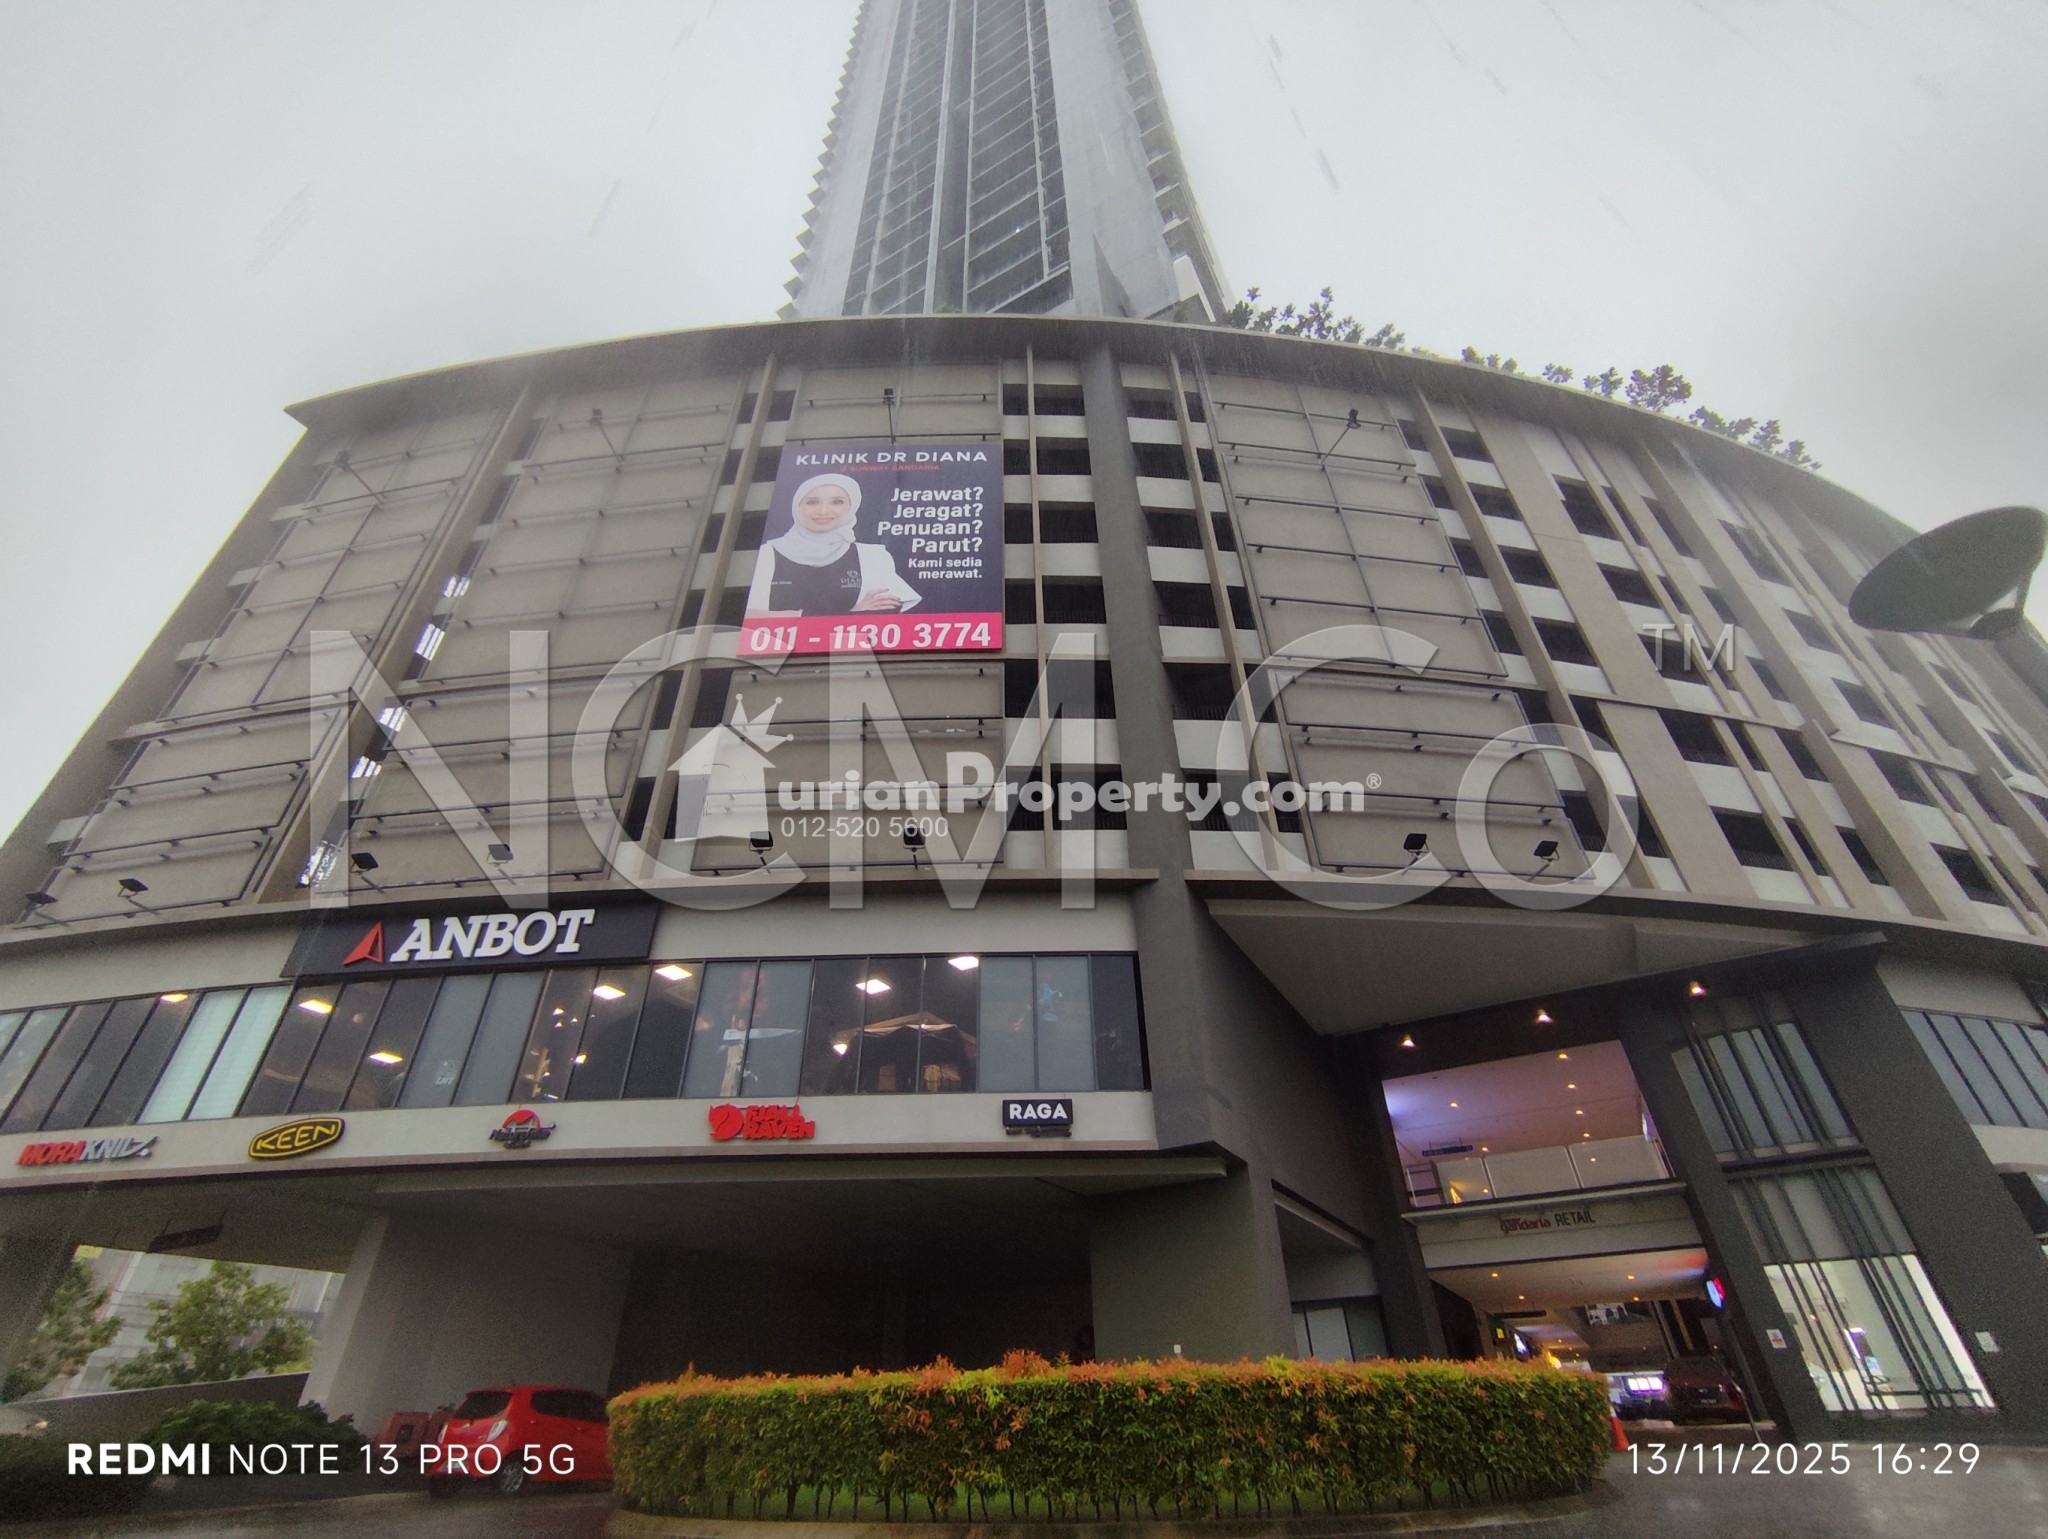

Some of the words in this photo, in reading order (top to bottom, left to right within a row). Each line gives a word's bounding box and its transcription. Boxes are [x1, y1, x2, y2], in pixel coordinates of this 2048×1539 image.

[796, 452, 868, 466] KLINIK
[877, 452, 907, 463] DR
[916, 451, 988, 463] DIANA
[891, 486, 984, 502] Jerawat?
[893, 503, 984, 521] Jeragat?
[877, 520, 984, 536] Penuaan?
[912, 537, 983, 553] Parut?
[908, 557, 943, 569] Kami
[945, 557, 983, 568] sedia
[918, 568, 983, 580] merawat.
[750, 626, 799, 652] 011
[809, 636, 821, 644] -
[832, 623, 901, 650] 1130
[912, 622, 991, 648] 3774
[389, 908, 596, 963] ANBOT
[1009, 1102, 1068, 1120] RAGA
[256, 1124, 336, 1150] KEEN
[1554, 1209, 1597, 1227] RETAIL
